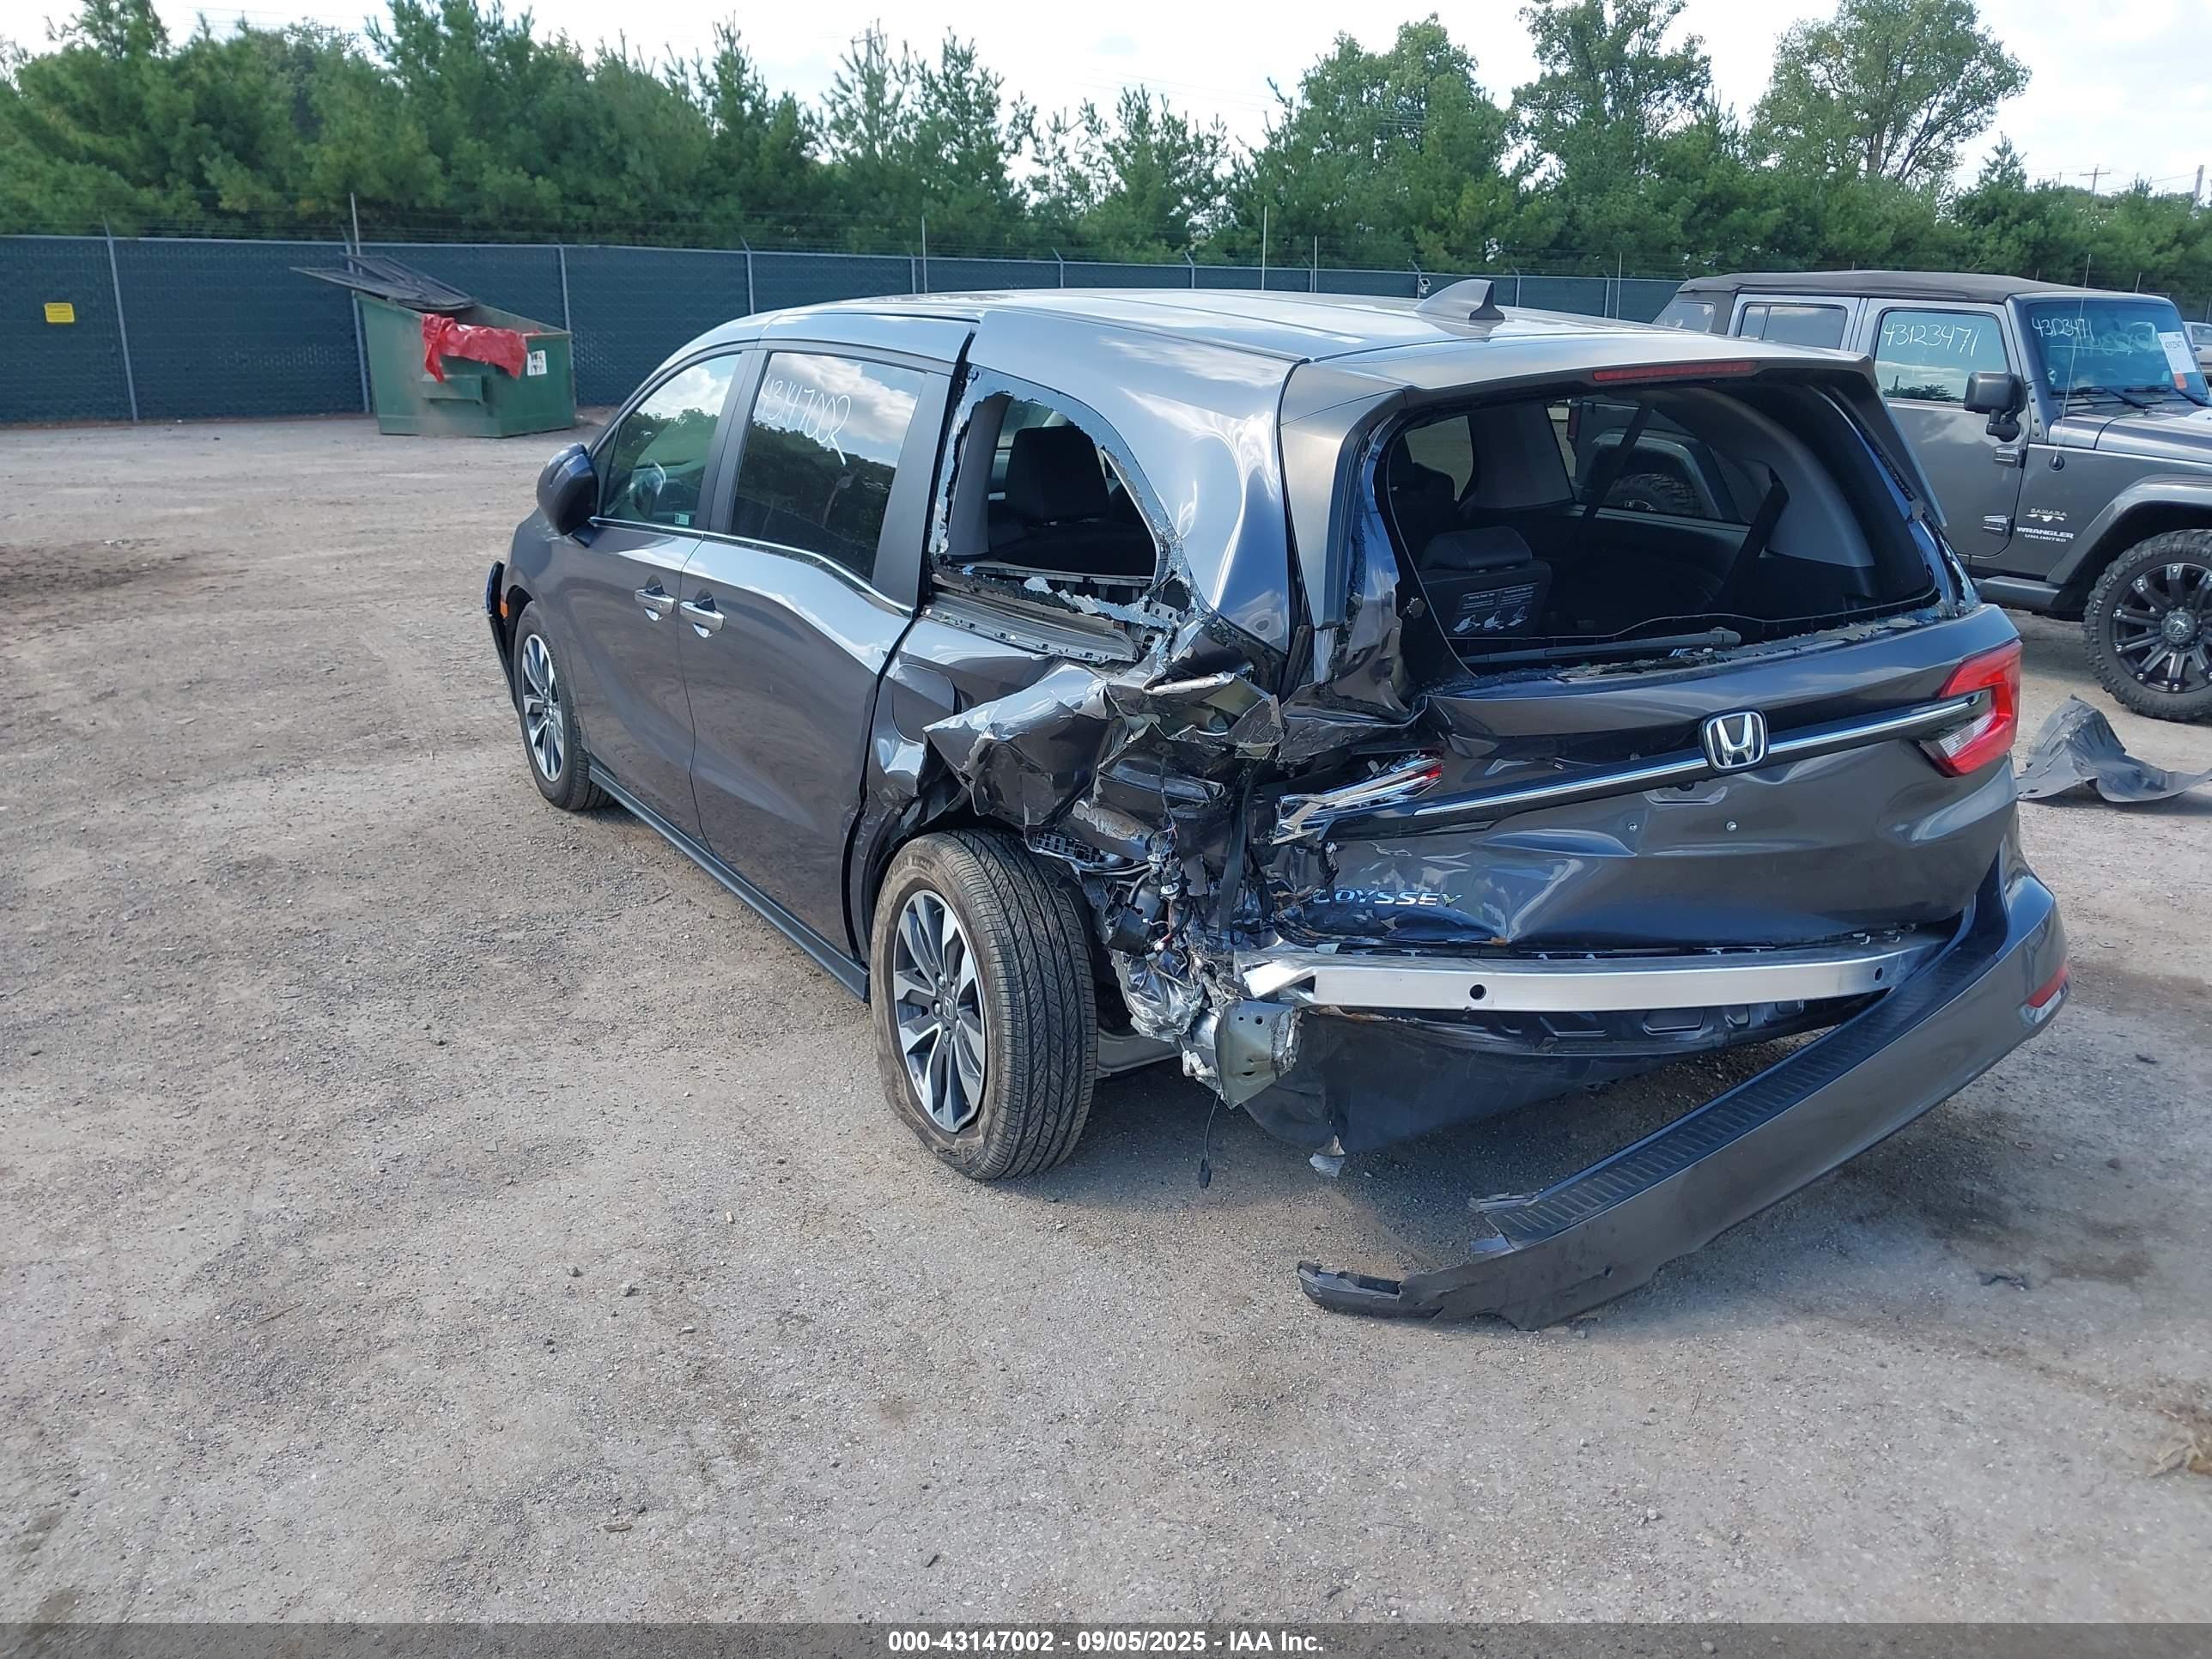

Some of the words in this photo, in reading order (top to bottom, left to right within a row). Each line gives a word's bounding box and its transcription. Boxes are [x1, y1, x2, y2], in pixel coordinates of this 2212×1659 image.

[1883, 322, 1981, 358] 43123471
[761, 373, 851, 466] 43147002
[2030, 507, 2068, 517] SAHARA
[2016, 526, 2075, 539] WRANGLER
[2024, 533, 2067, 543] UNLIMITED
